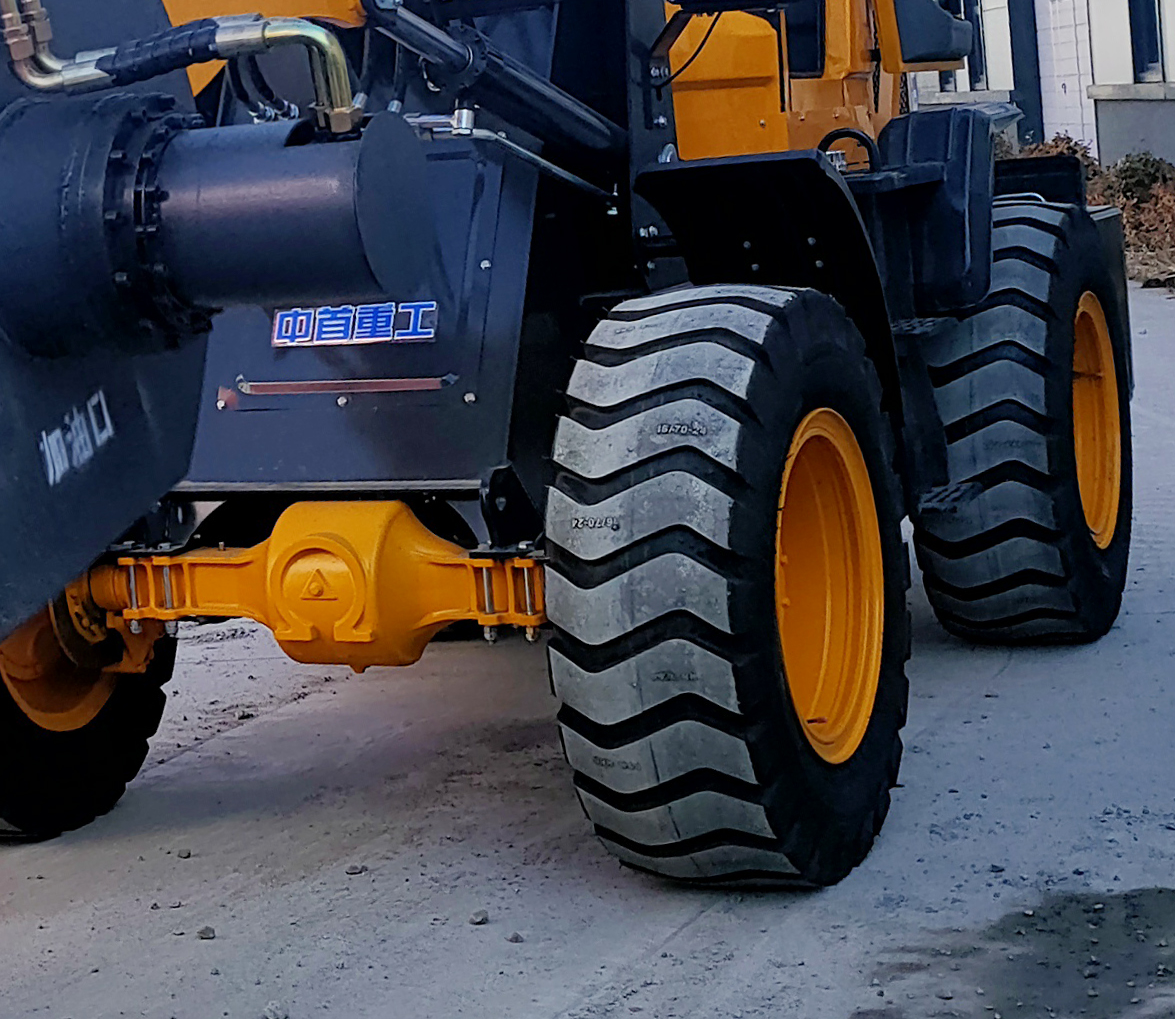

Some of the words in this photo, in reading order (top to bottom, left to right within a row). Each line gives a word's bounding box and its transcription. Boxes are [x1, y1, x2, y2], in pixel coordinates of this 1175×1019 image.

[273, 301, 437, 346] 中首重工
[38, 391, 114, 486] 加油口
